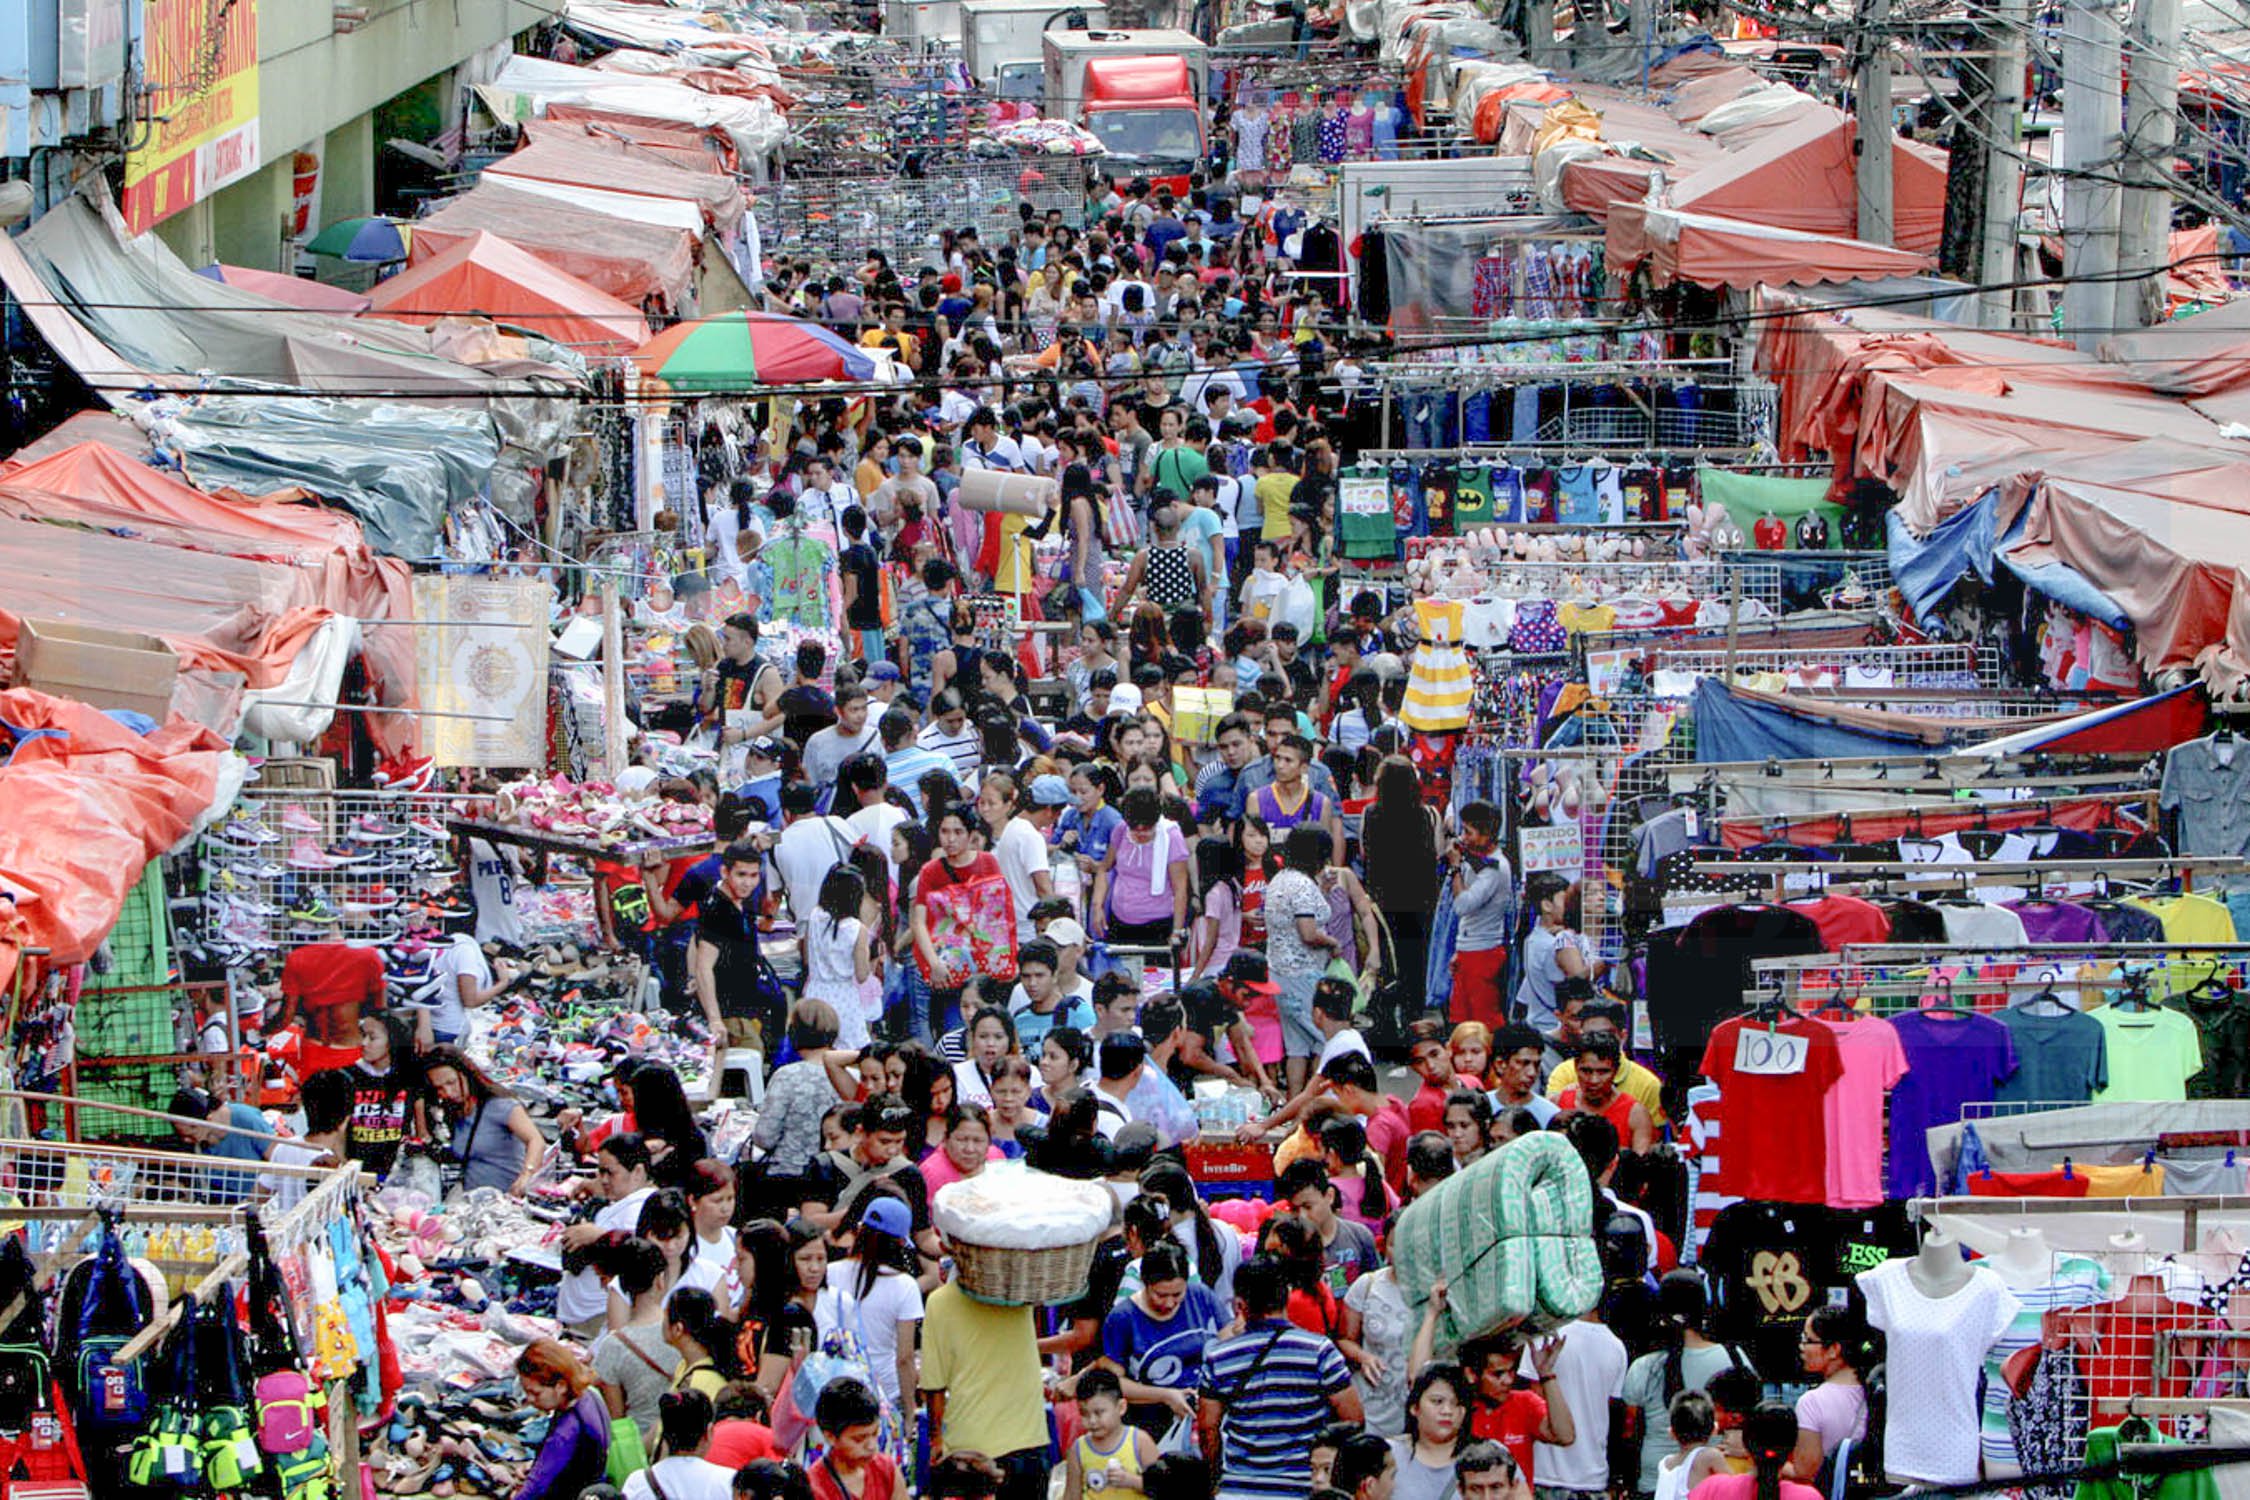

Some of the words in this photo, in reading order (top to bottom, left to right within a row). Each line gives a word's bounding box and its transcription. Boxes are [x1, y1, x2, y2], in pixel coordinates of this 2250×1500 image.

[1130, 168, 1162, 176] ISUZU
[1527, 827, 1577, 840] SANDO
[500, 875, 512, 905] 8
[1743, 1034, 1797, 1071] 100
